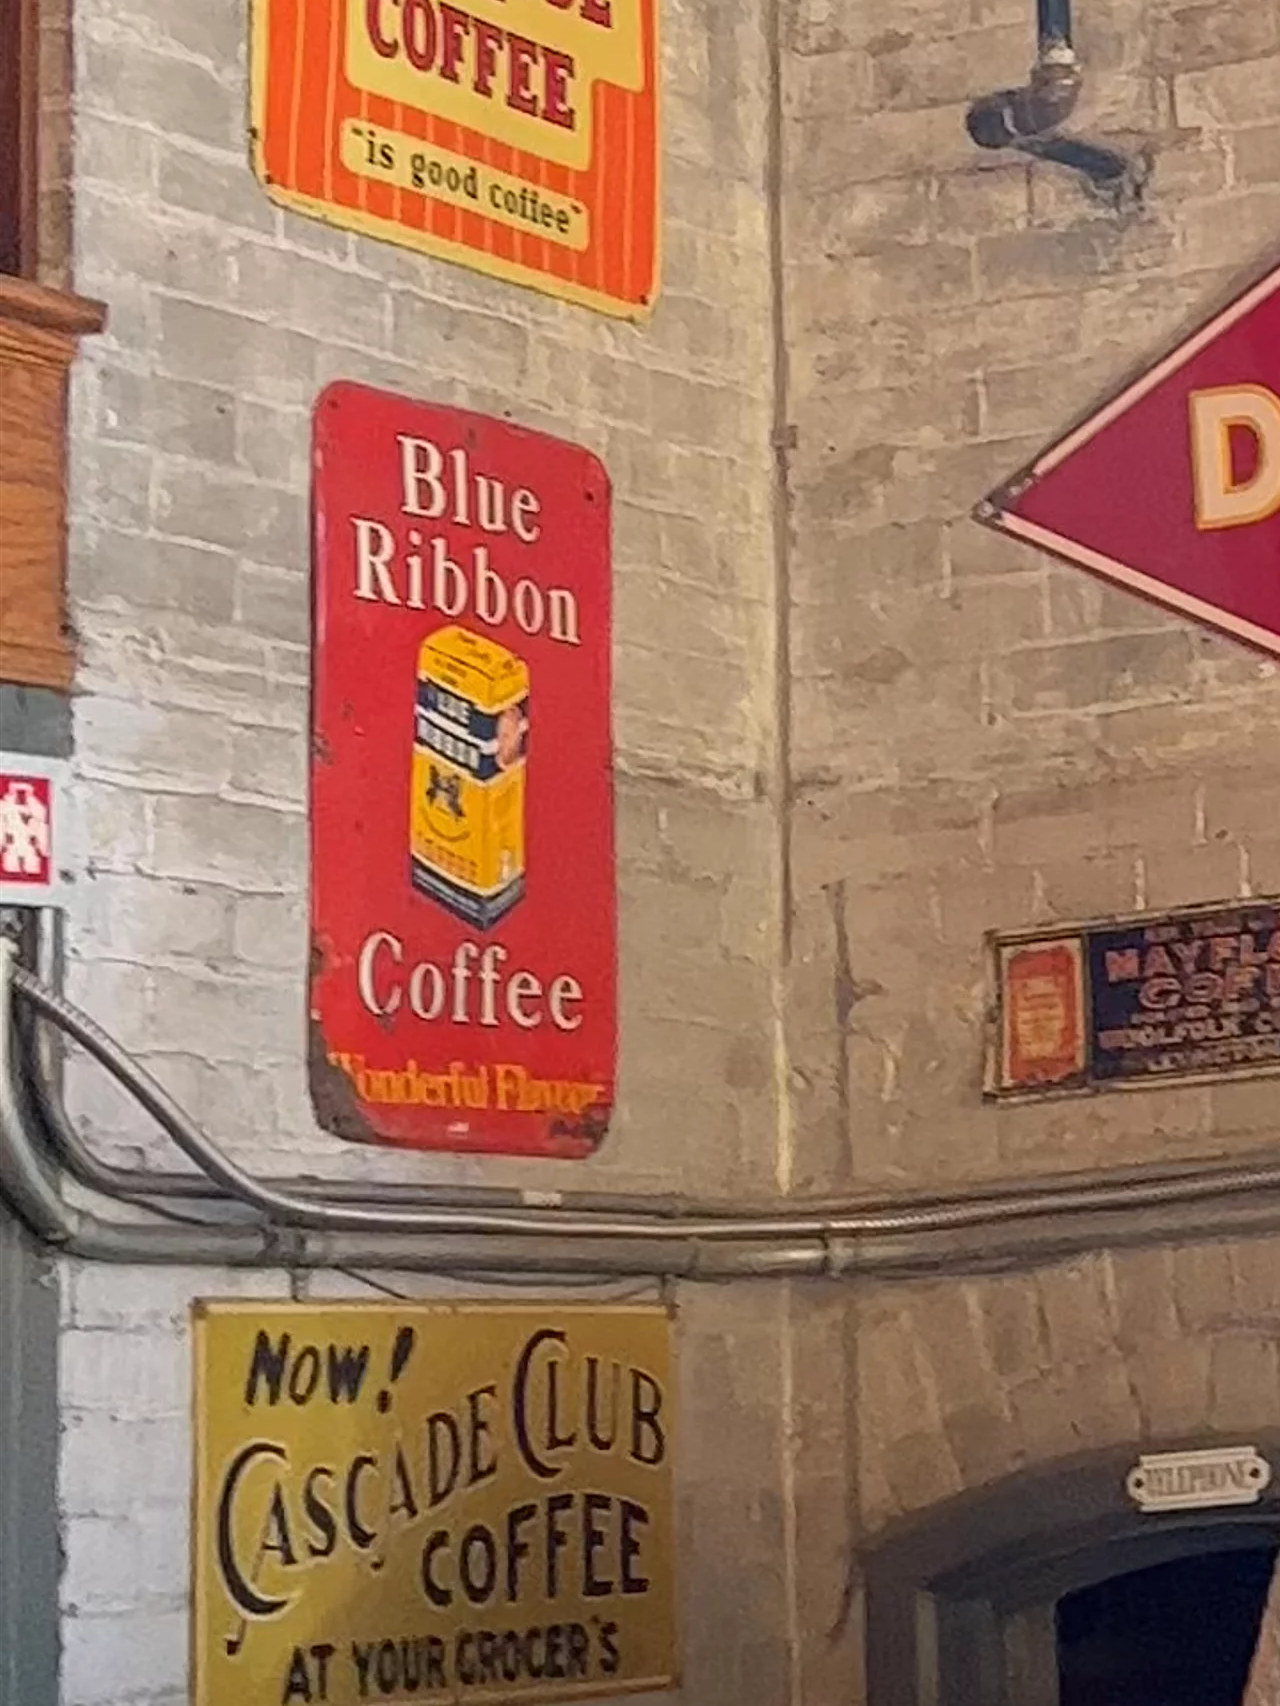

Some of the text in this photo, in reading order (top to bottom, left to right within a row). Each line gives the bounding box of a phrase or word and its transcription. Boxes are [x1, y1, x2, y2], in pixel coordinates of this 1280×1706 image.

[410, 152, 480, 199] good
[396, 434, 542, 543] Blue
[349, 518, 581, 648] Ribbon
[356, 930, 584, 1030] Coffee
[245, 1326, 415, 1413] NOW!
[217, 1328, 666, 1618] CASCADE CLUB
[421, 1493, 650, 1608] COFFEE
[282, 1643, 335, 1706] AT
[352, 1634, 446, 1696] YOUR
